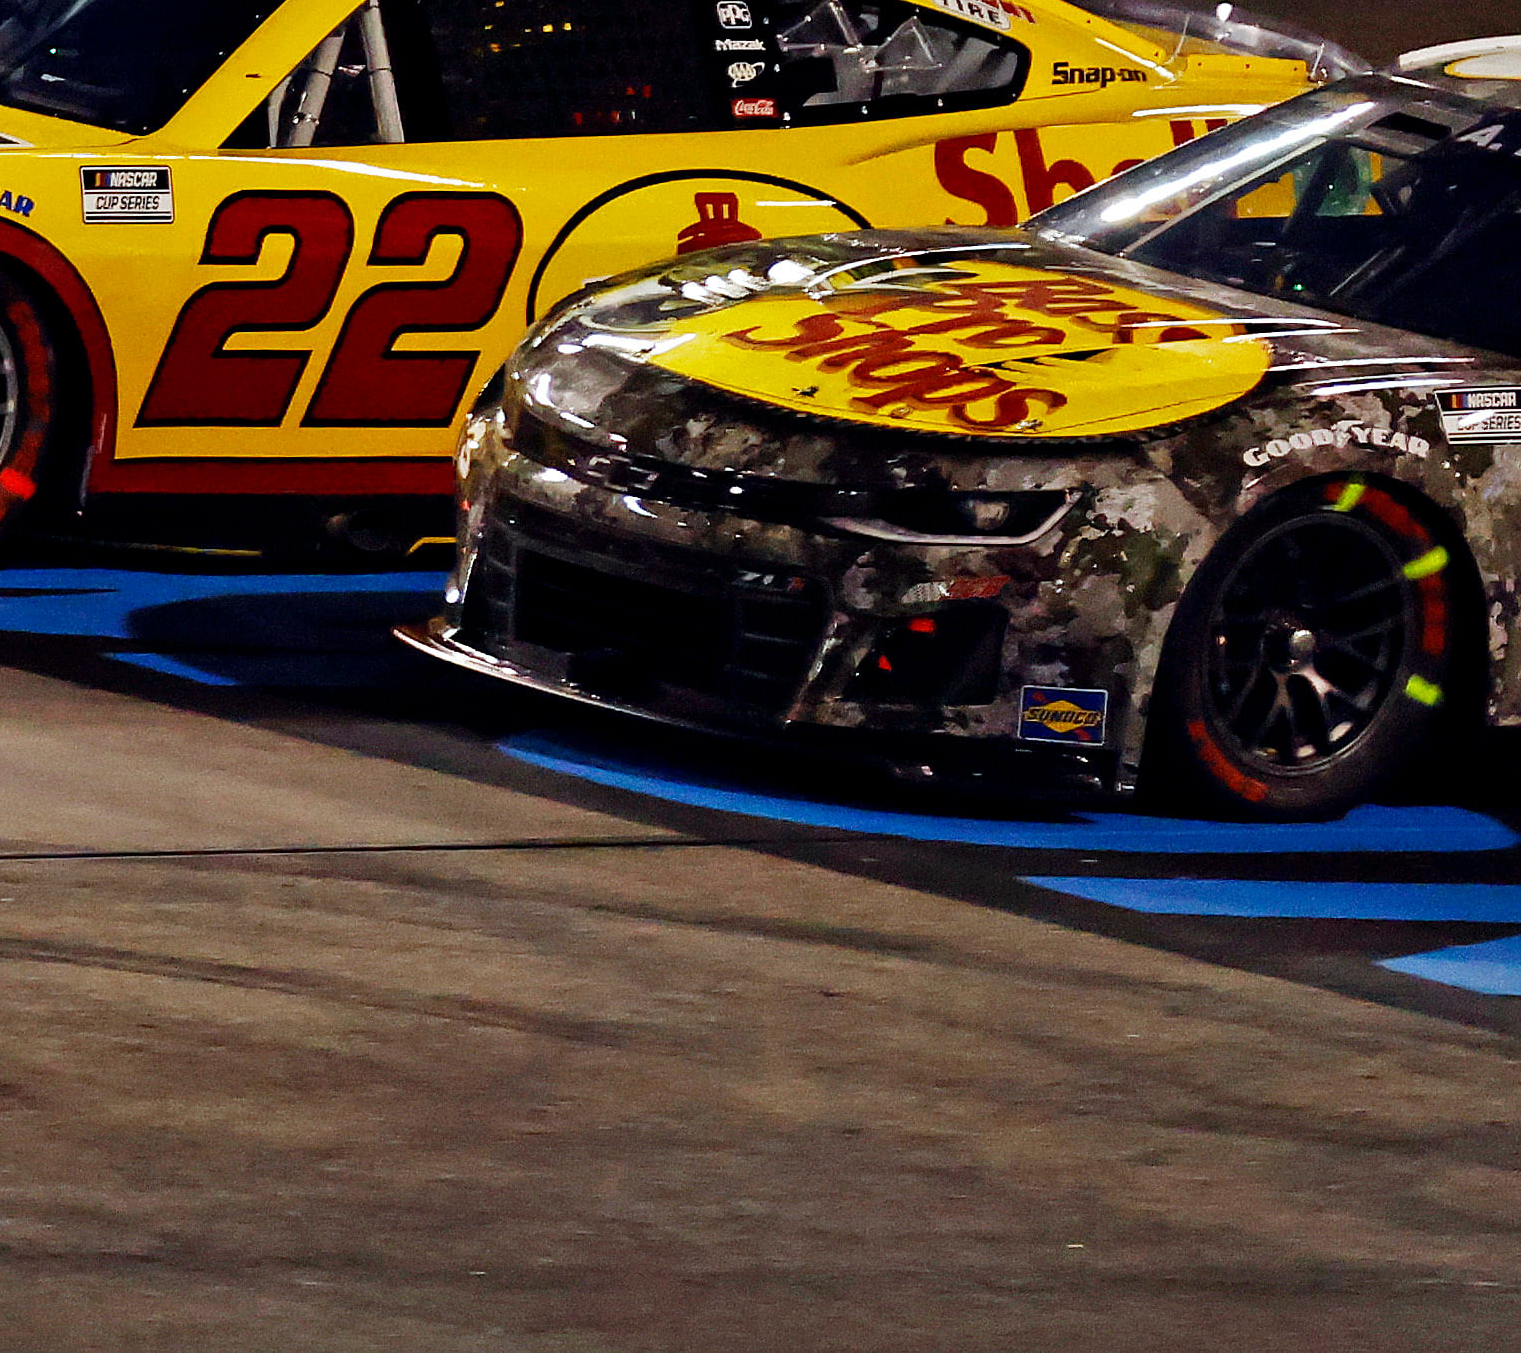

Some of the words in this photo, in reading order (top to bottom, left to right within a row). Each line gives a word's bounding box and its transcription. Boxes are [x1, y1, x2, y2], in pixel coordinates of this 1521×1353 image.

[1052, 62, 1147, 88] Snap-on
[1456, 124, 1505, 151] A.
[107, 170, 159, 188] NASCAR
[95, 194, 121, 211] CUP
[121, 194, 160, 211] SERIES
[133, 189, 524, 429] 22
[721, 314, 1070, 428] Shops
[1467, 392, 1518, 408] NASCAR
[1243, 419, 1431, 467] GOODYEAR
[1026, 705, 1101, 730] SUNOCO
